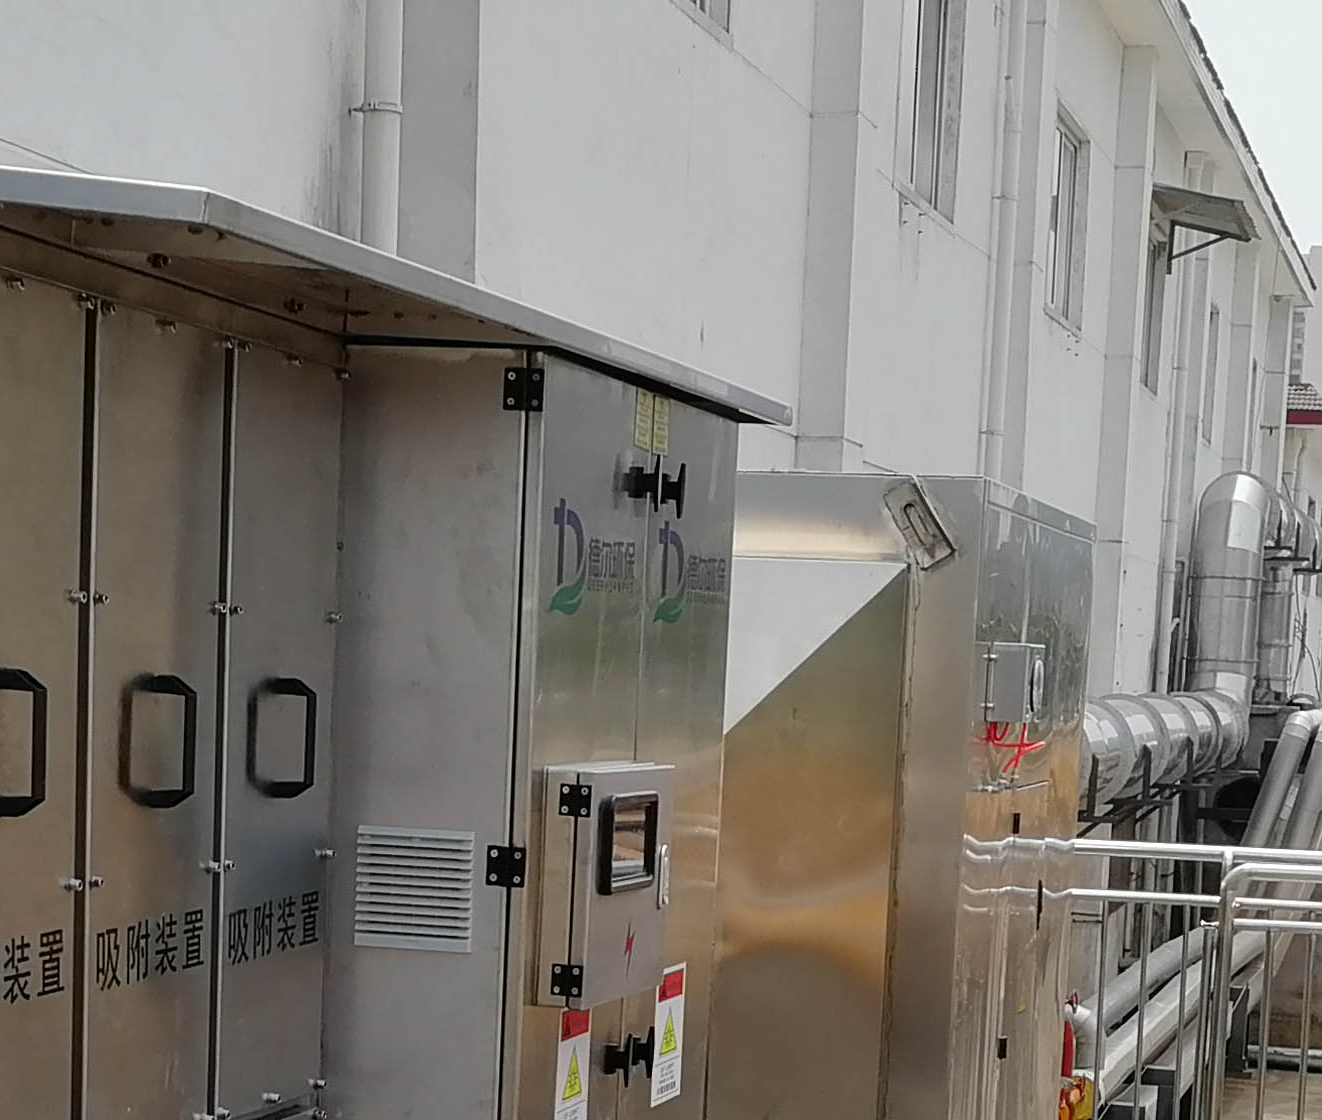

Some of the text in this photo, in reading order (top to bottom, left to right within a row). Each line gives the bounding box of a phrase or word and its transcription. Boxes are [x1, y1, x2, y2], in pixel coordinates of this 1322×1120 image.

[95, 908, 204, 991] 吸附装置
[227, 891, 320, 967] 吸附装置
